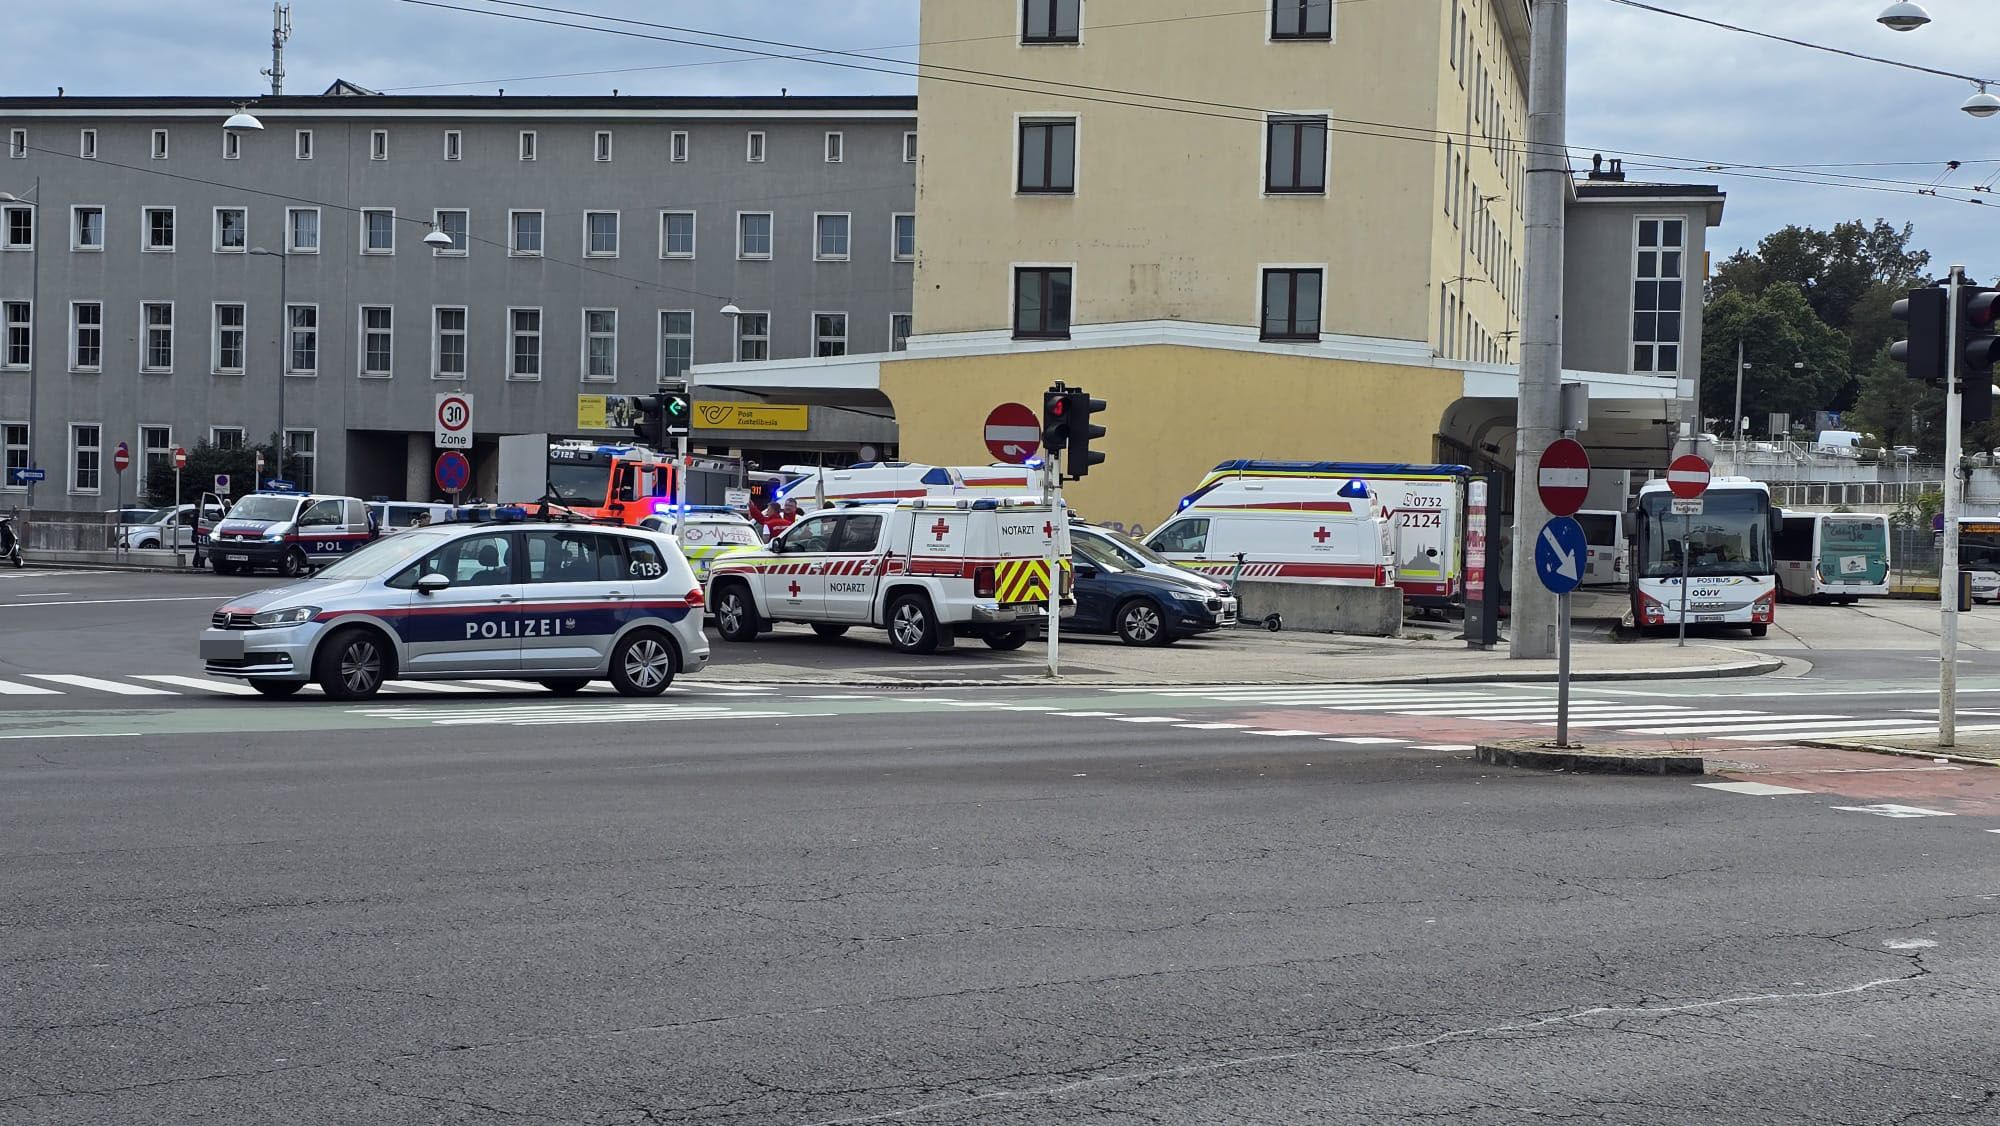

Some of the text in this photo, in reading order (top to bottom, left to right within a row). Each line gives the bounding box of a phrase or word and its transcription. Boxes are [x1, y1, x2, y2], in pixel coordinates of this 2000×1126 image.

[446, 406, 462, 423] 30
[737, 411, 753, 419] Post
[440, 433, 467, 445] Zone
[560, 451, 575, 459] 122
[1413, 497, 1442, 507] 0732
[1402, 514, 1442, 528] 2124
[1001, 525, 1035, 536] NOTARZT
[316, 541, 343, 551] POL
[639, 562, 662, 577] 133
[830, 583, 866, 593] NOTARZT
[465, 618, 561, 639] POLIZEI
